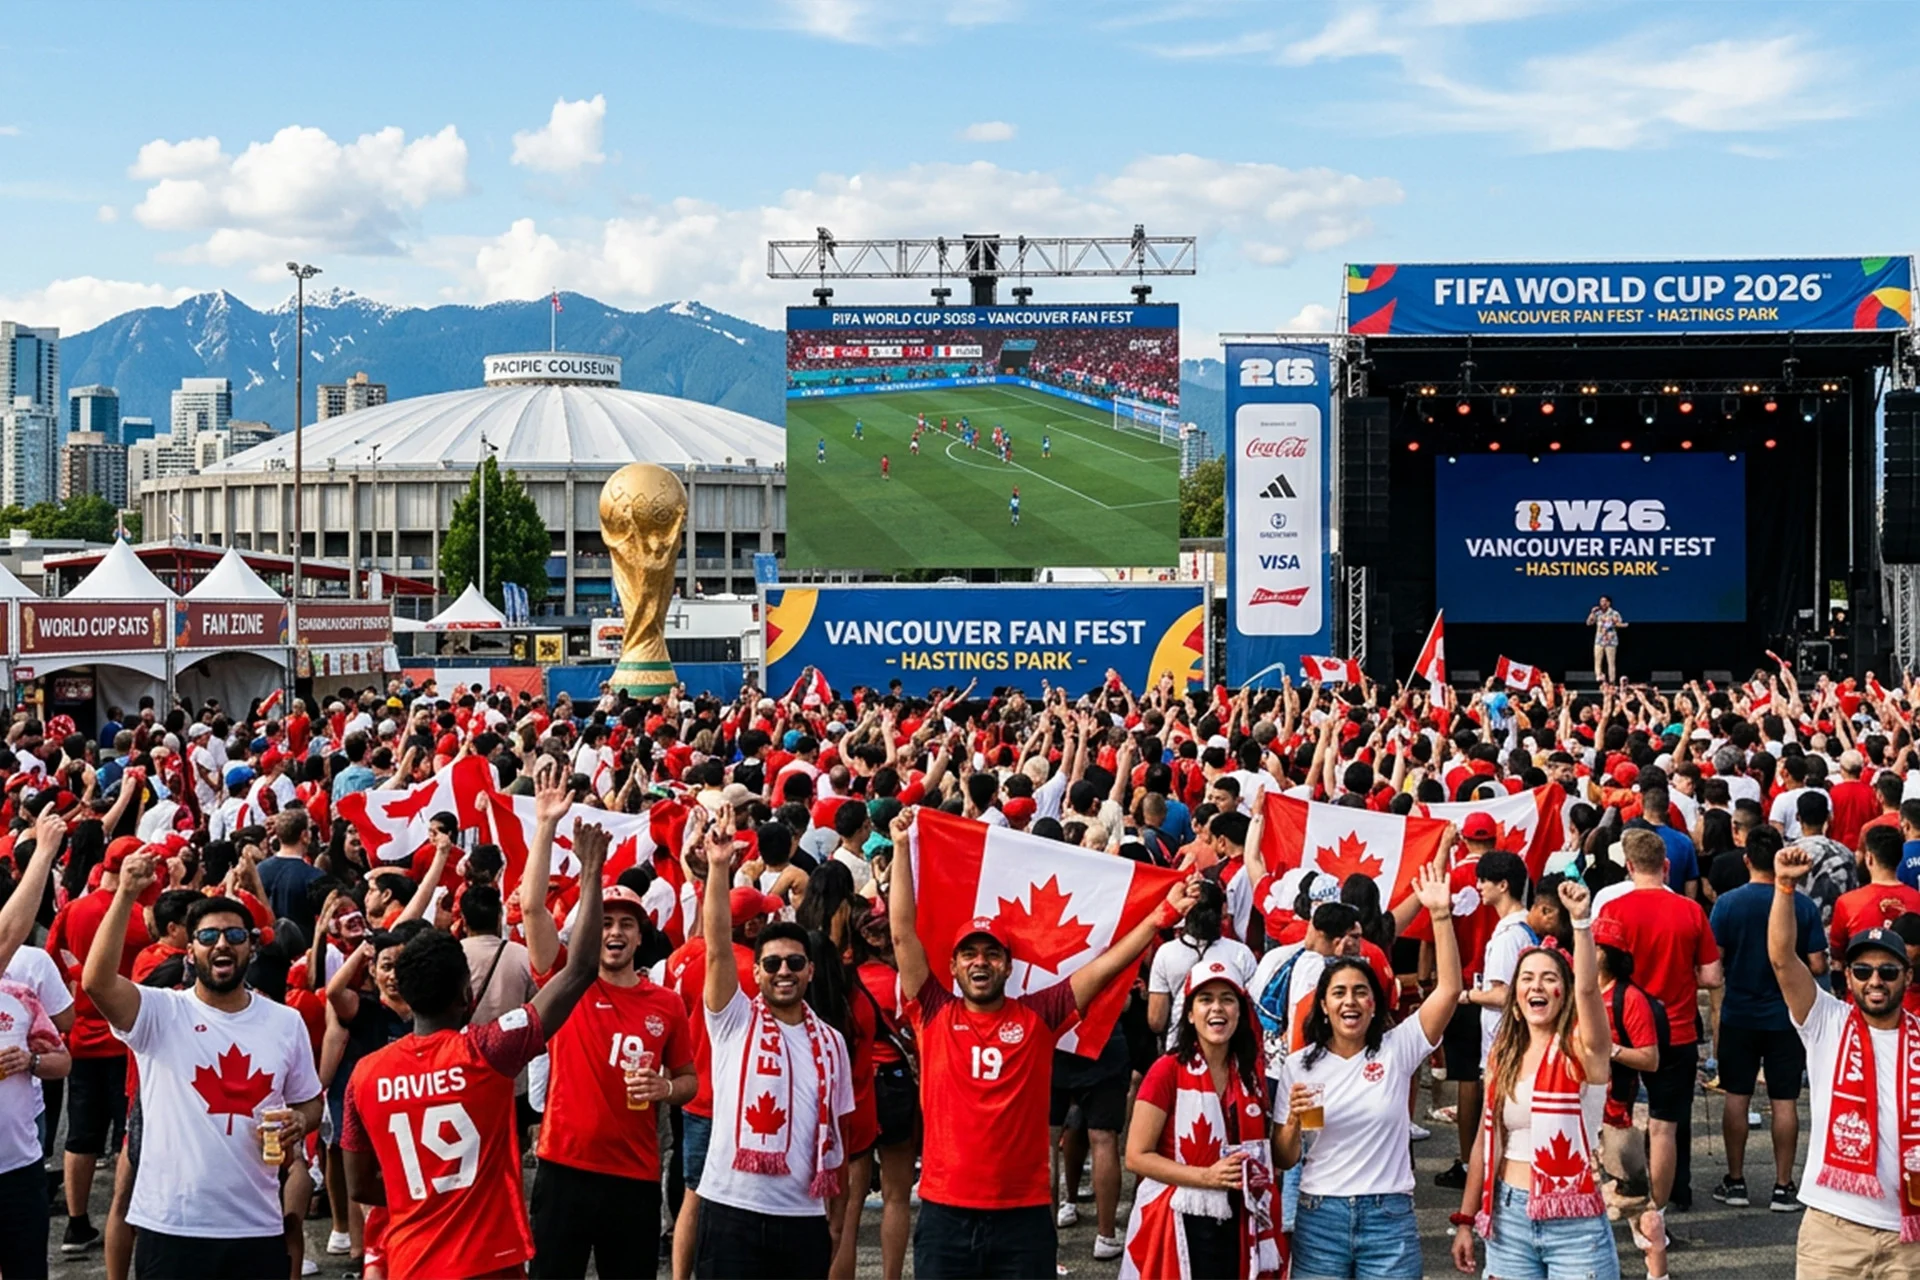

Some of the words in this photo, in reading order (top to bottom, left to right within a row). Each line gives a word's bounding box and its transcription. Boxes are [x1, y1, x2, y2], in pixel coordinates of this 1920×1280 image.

[1434, 278, 1511, 305] FIFA
[1515, 277, 1647, 304] WORLD
[1653, 275, 1727, 302] CUP
[1734, 273, 1822, 302] 2026
[863, 312, 912, 325] WORLD
[913, 312, 941, 324] CUP
[987, 311, 1069, 324] VANCOUVER
[1072, 311, 1098, 323] FAN
[1101, 311, 1134, 323] FEST
[1477, 309, 1571, 324] VANCOUVER
[1608, 309, 1645, 322] FEST
[1738, 307, 1779, 320] PARK
[1465, 538, 1604, 557] VANCOUVER
[1610, 538, 1654, 556] FAN
[1660, 537, 1716, 556] FEST
[1259, 555, 1301, 569] VISA
[1526, 562, 1609, 576] HASTINGS
[1613, 562, 1658, 576] PARK
[38, 617, 88, 637] WORLD
[90, 616, 117, 636] CUP
[118, 616, 149, 636] SATS
[824, 620, 1000, 645] VANCOUVER
[1009, 620, 1067, 644] FAN
[1074, 620, 1146, 644] FEST
[901, 651, 1009, 670] HASTINGS
[1014, 651, 1072, 670] PARK
[608, 1032, 644, 1072] 19
[971, 1046, 1003, 1080] 19
[377, 1066, 466, 1102] DAVIES
[388, 1102, 481, 1200] 19
